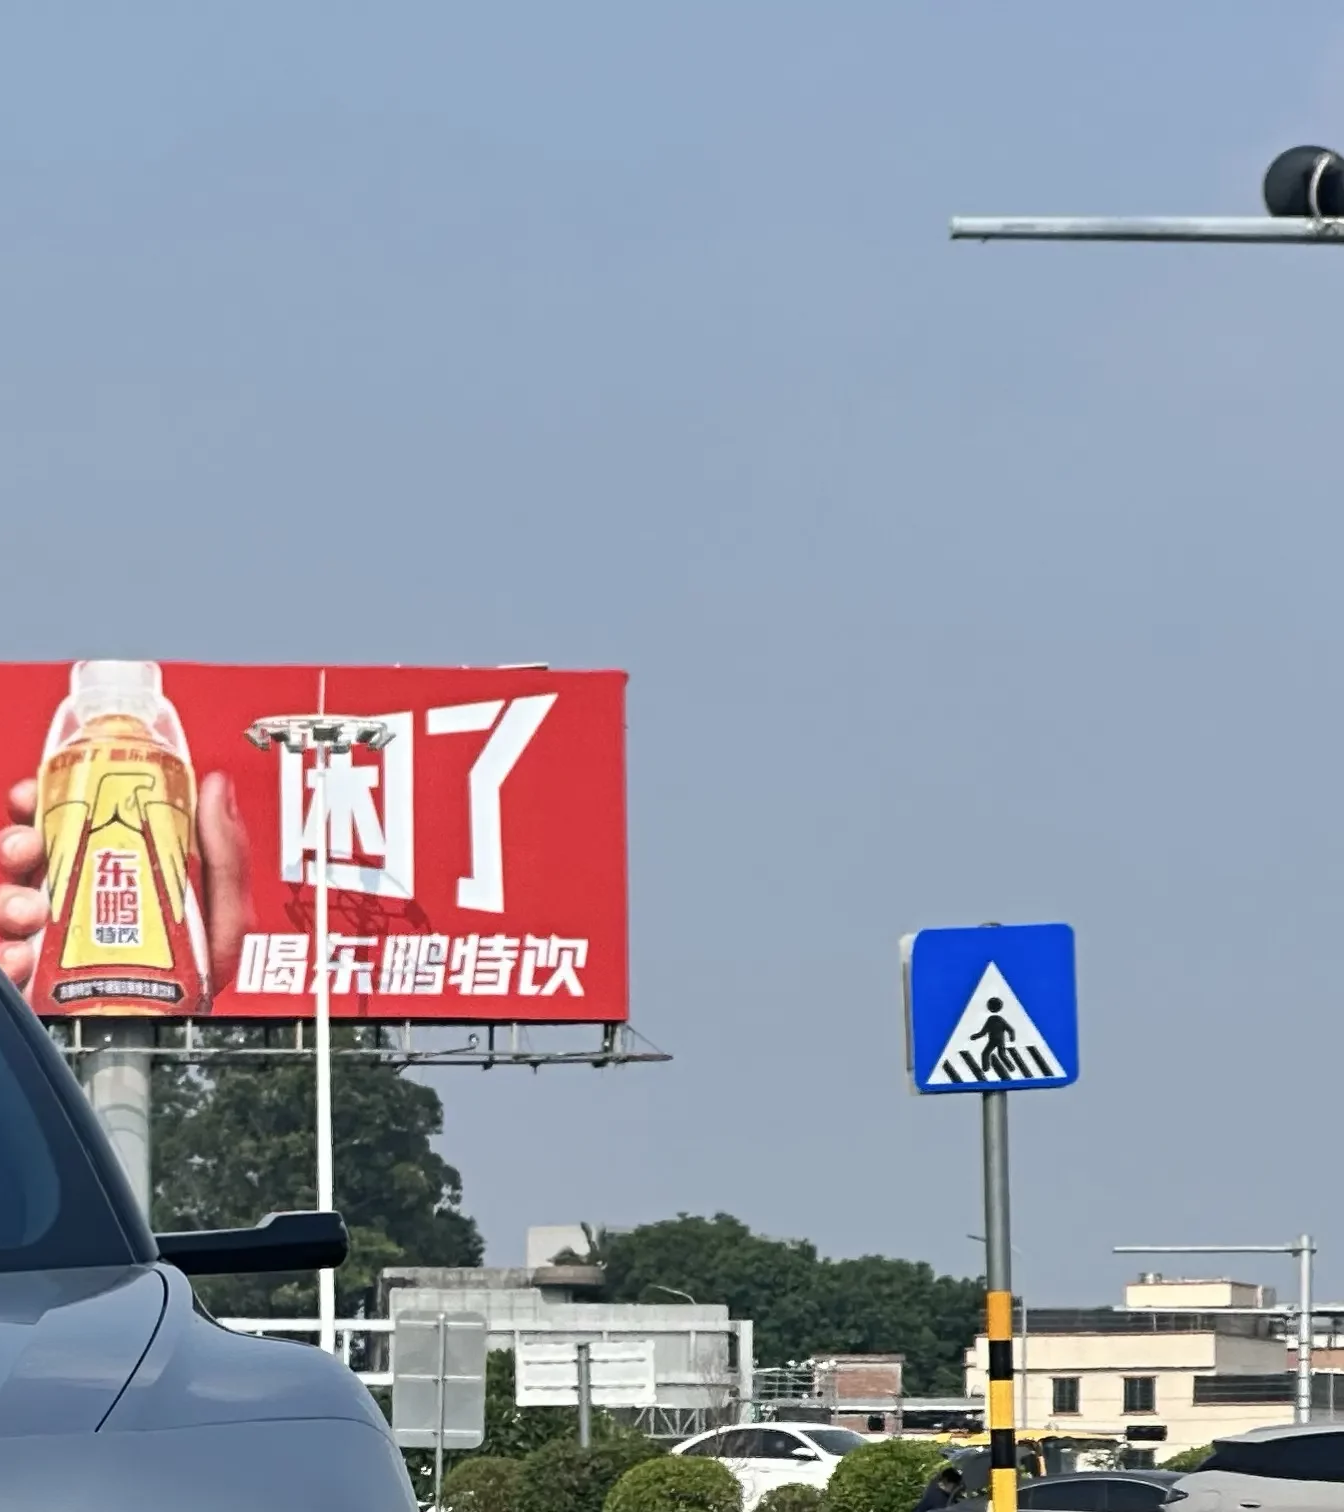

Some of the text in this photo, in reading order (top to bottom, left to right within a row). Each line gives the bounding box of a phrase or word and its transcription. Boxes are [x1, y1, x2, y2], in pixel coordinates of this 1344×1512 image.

[278, 693, 558, 913] 困了
[236, 933, 588, 996] 喝东鹏特饮
